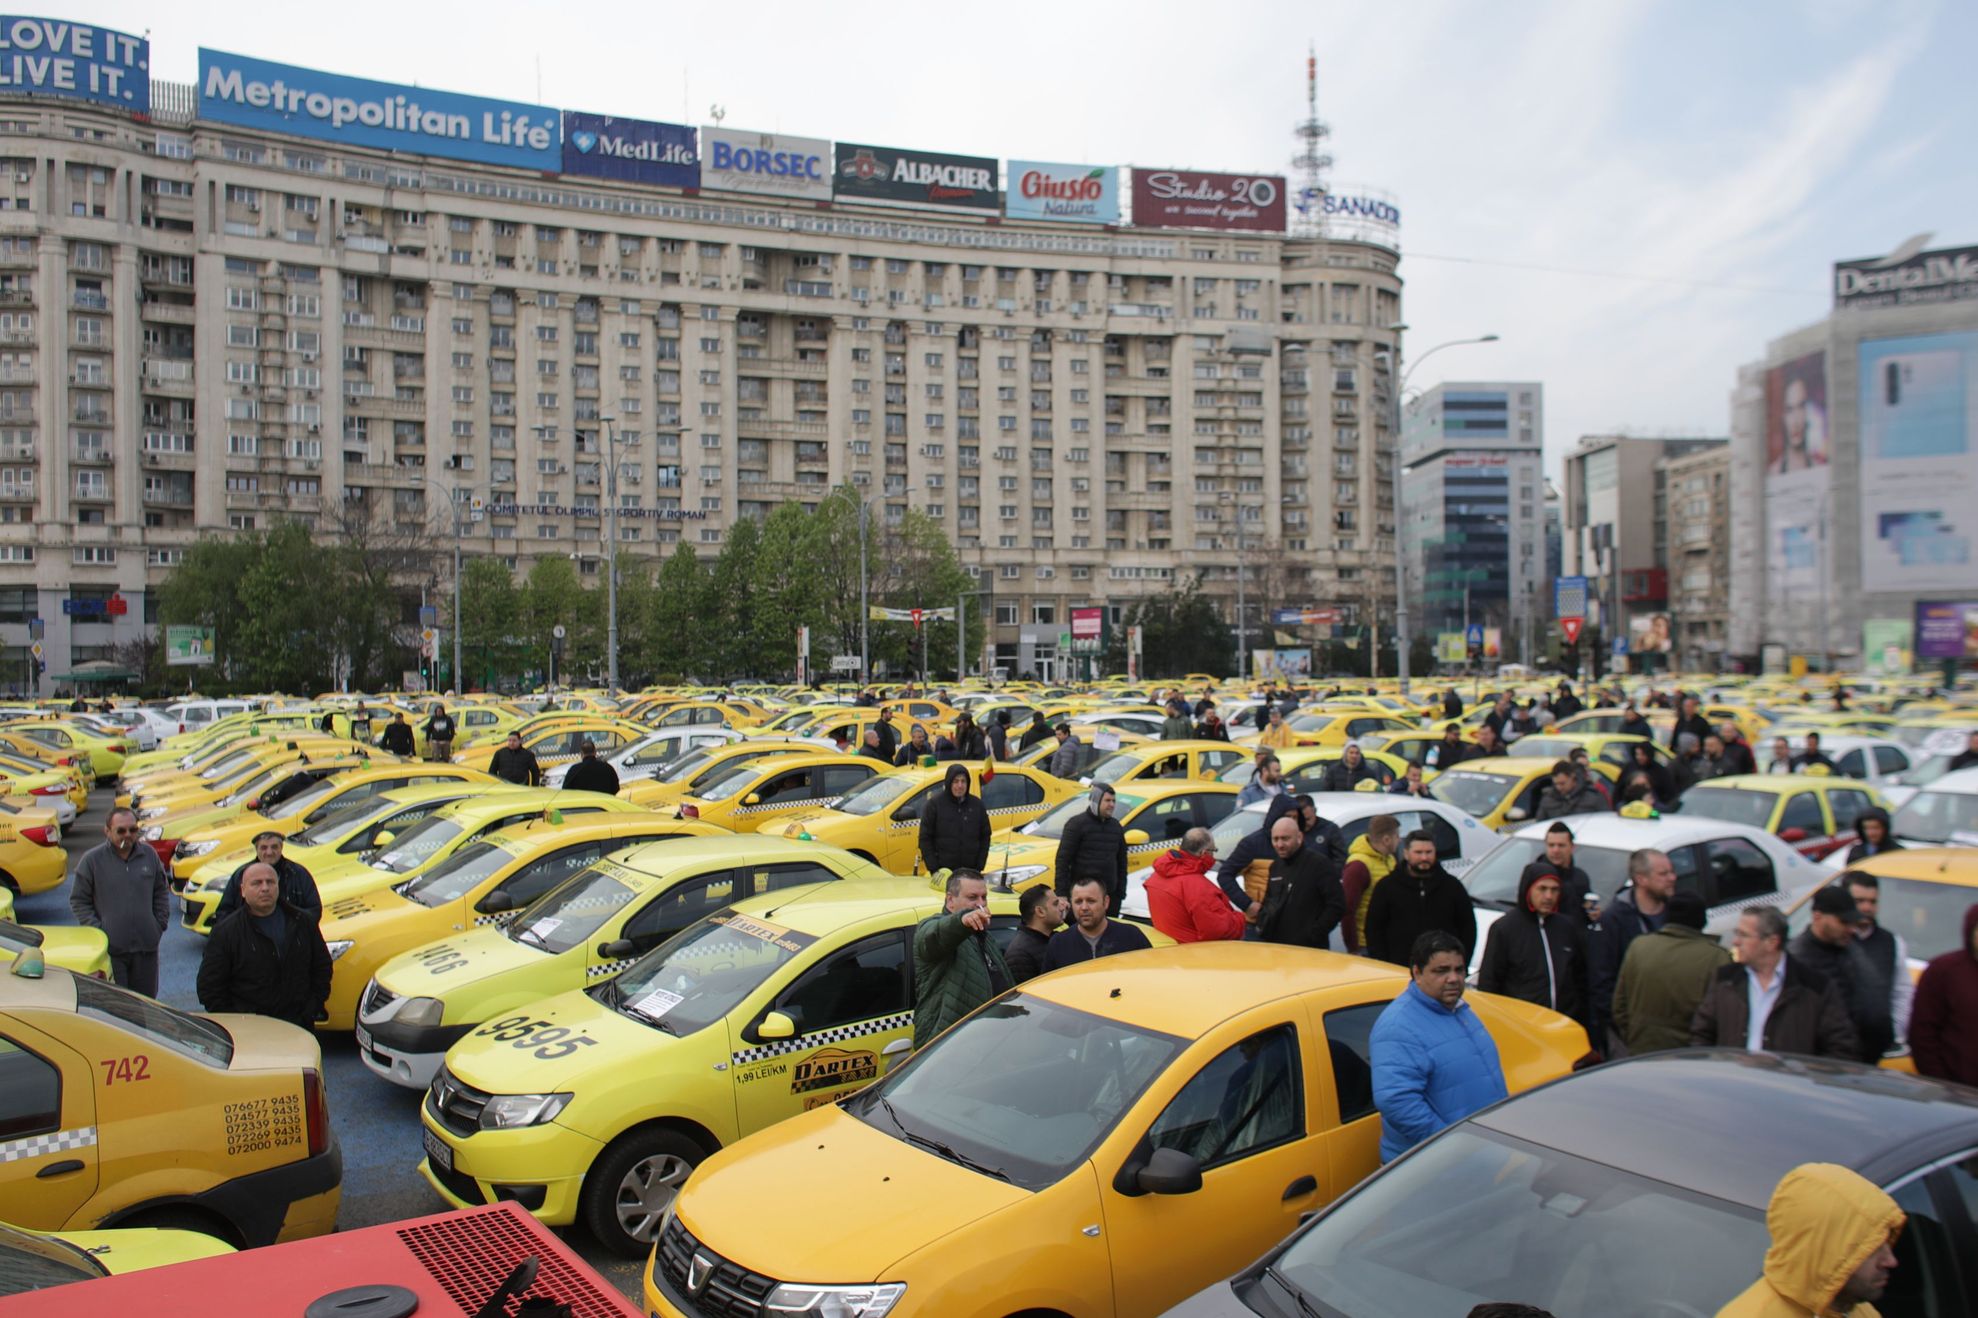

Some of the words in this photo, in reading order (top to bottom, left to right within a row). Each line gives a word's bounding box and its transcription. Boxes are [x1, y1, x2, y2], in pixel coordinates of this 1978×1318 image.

[105, 31, 147, 71] IT.
[89, 63, 133, 100] IT.
[205, 65, 470, 139] Metropolitan
[600, 134, 693, 165] MedLife
[712, 140, 822, 180] BORSEC
[892, 157, 997, 192] ALBACHER
[1021, 170, 1103, 200] Giusto
[1147, 172, 1228, 201] Studio
[1231, 177, 1276, 207] 20
[1043, 201, 1097, 217] Natura
[484, 504, 551, 515] COMITETUL
[555, 506, 600, 518] OLIMPIC
[616, 508, 663, 519] SPORTIV
[475, 1016, 599, 1060] 9595
[101, 1055, 151, 1086] 742
[736, 1071, 754, 1084] 1,99
[755, 1064, 788, 1080] LEI/KM
[794, 1055, 873, 1080] D'ARTEX
[839, 1066, 877, 1084] TAXI
[224, 1099, 267, 1114] 076677
[271, 1094, 299, 1106] 9435
[225, 1109, 268, 1124] 074577
[272, 1104, 300, 1116] 9435
[226, 1120, 270, 1134] 072339
[273, 1115, 301, 1126] 9435
[227, 1130, 271, 1145] 072269
[274, 1125, 302, 1137] 9435
[228, 1140, 271, 1156] 072000
[274, 1136, 302, 1147] 9474
